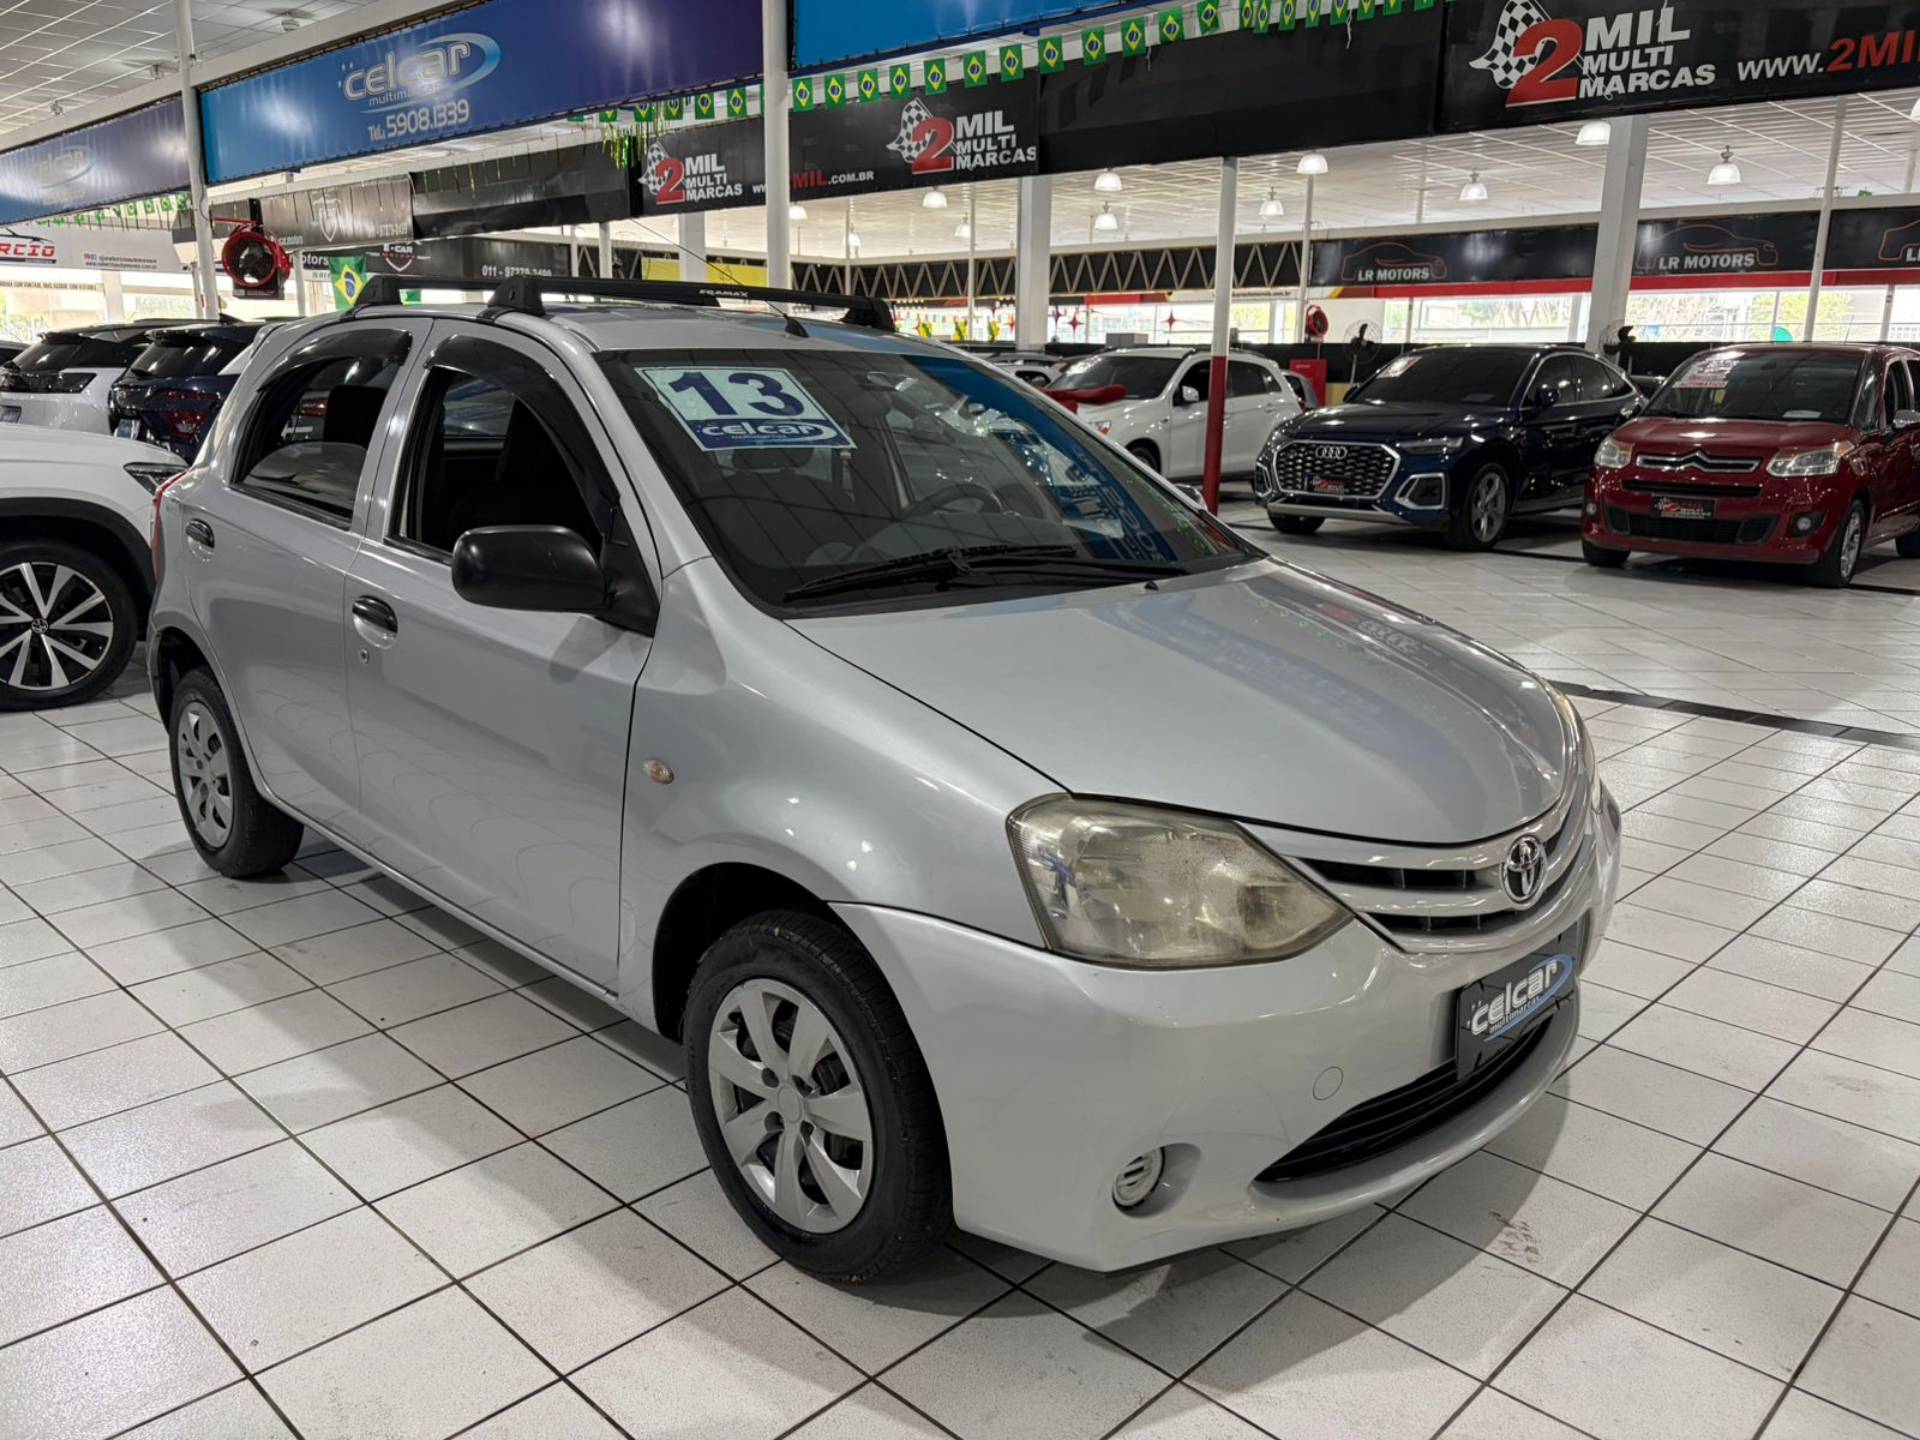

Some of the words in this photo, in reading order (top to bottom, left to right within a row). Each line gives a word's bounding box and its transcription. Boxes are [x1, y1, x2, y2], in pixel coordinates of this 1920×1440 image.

[343, 41, 471, 100] celcar
[1506, 18, 1584, 109] 2
[1584, 6, 1691, 52] MIL
[1583, 44, 1675, 76] MULTI
[1578, 63, 1716, 99] MARCAS
[386, 98, 470, 138] 5908.1339
[912, 116, 955, 175] 2
[956, 110, 1015, 140] MIL
[956, 133, 1017, 155] MULTI
[956, 145, 1037, 171] MARCAS
[656, 156, 686, 205] 2
[685, 153, 726, 175] MIL
[685, 172, 727, 189] MULTI
[685, 182, 743, 201] MARCAS
[482, 264, 497, 277] 011
[1357, 269, 1375, 282] LR
[1377, 267, 1430, 281] MOTORS
[1658, 255, 1679, 270] LR
[1684, 253, 1755, 270] MOTORS
[668, 371, 805, 417] 13
[701, 422, 818, 437] celcar
[1471, 958, 1558, 1036] celcar
